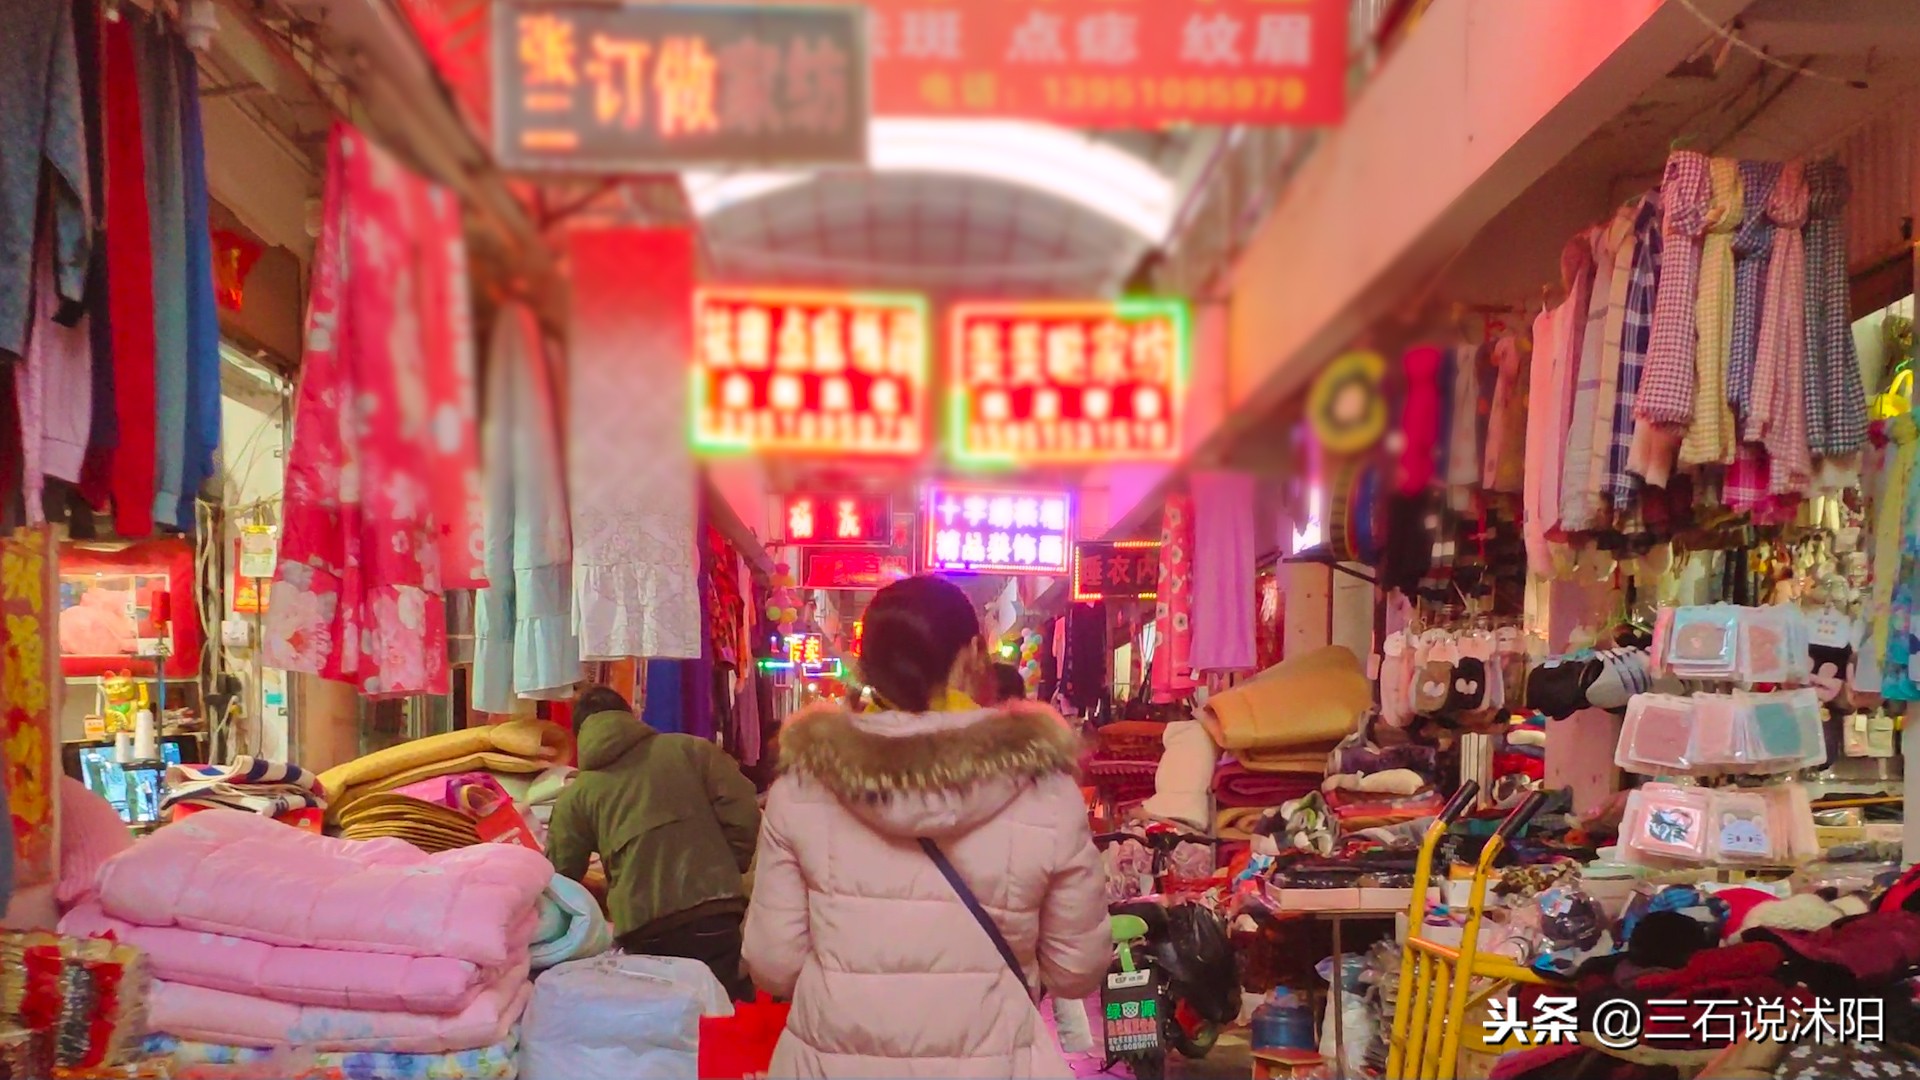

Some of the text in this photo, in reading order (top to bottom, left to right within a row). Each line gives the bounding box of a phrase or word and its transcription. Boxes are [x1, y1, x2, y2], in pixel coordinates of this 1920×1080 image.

[1007, 10, 1138, 63] 点痣
[1179, 13, 1313, 65] 纹眉
[584, 32, 847, 137] 订做家纺
[1107, 999, 1156, 1019] 绿源
